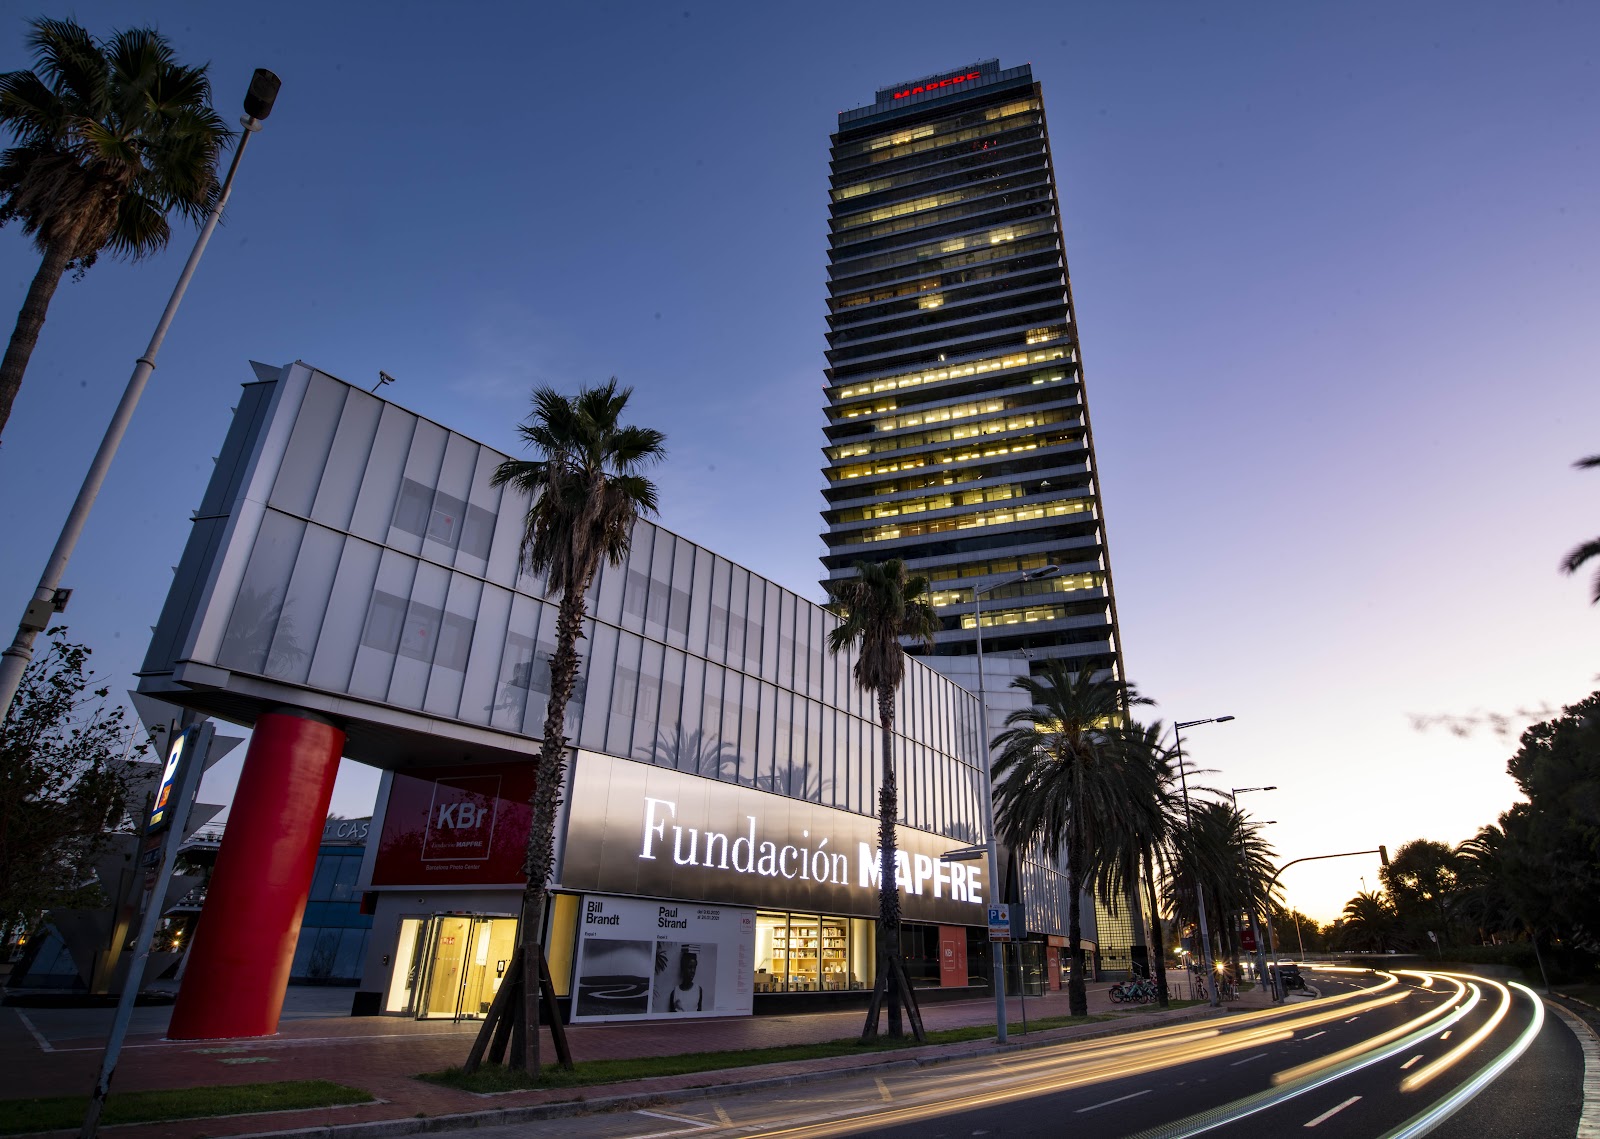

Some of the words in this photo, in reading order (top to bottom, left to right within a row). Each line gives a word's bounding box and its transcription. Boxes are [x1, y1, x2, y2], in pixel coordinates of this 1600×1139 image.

[437, 803, 488, 829] KBr
[456, 840, 483, 848] MAPFRE
[639, 797, 849, 885] Fundación
[859, 842, 983, 904] MAPFRE
[587, 901, 603, 913] Bill
[658, 906, 678, 918] Paul
[586, 912, 620, 926] Brandt
[990, 910, 997, 920] P
[657, 917, 687, 929] Strand
